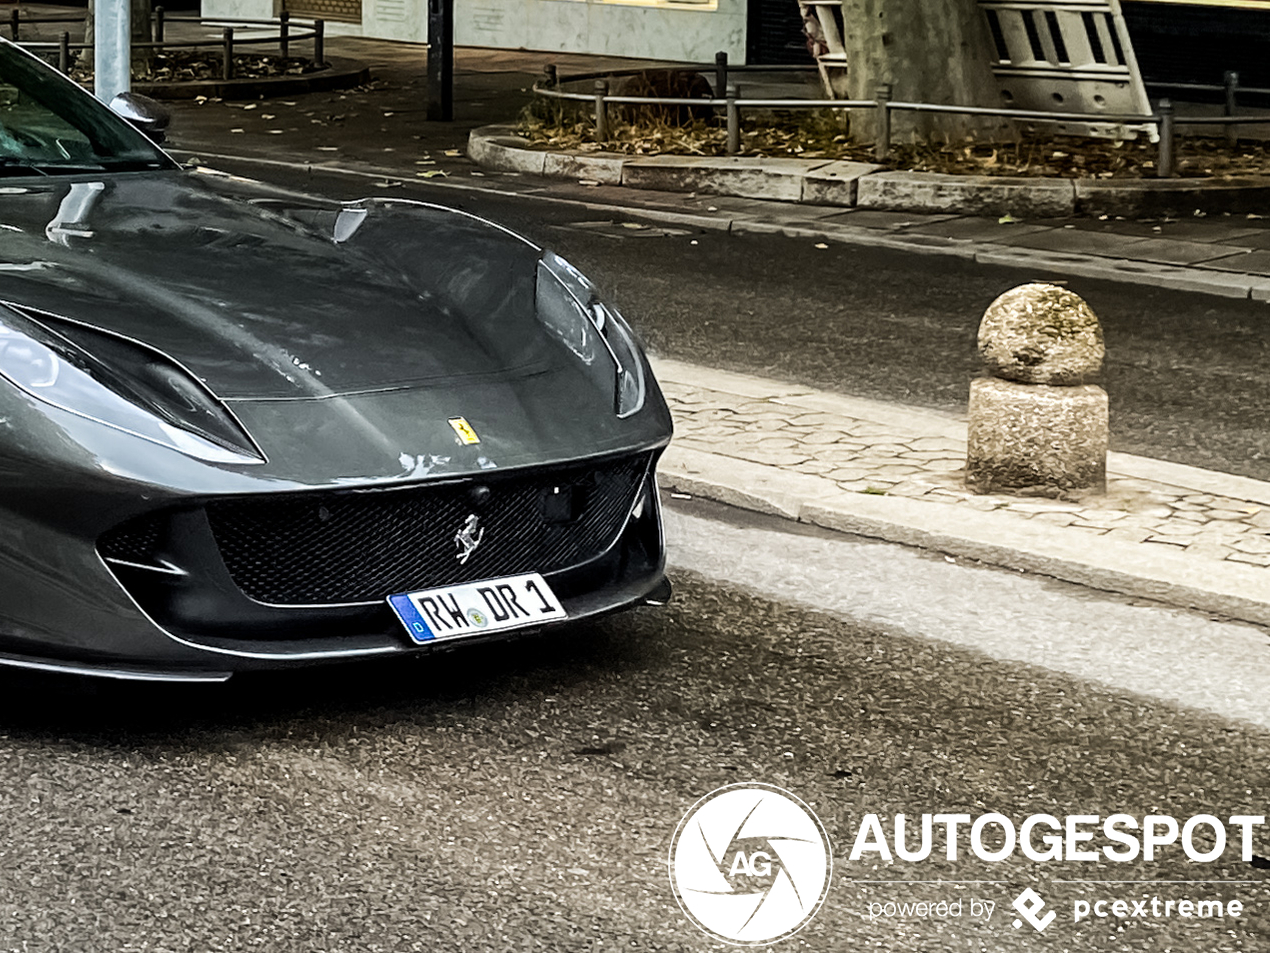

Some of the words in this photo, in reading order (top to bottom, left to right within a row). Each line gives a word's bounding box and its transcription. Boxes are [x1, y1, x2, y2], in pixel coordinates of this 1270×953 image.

[417, 593, 470, 631] RW
[477, 584, 530, 622] DR
[525, 579, 556, 614] 1
[412, 621, 424, 633] D
